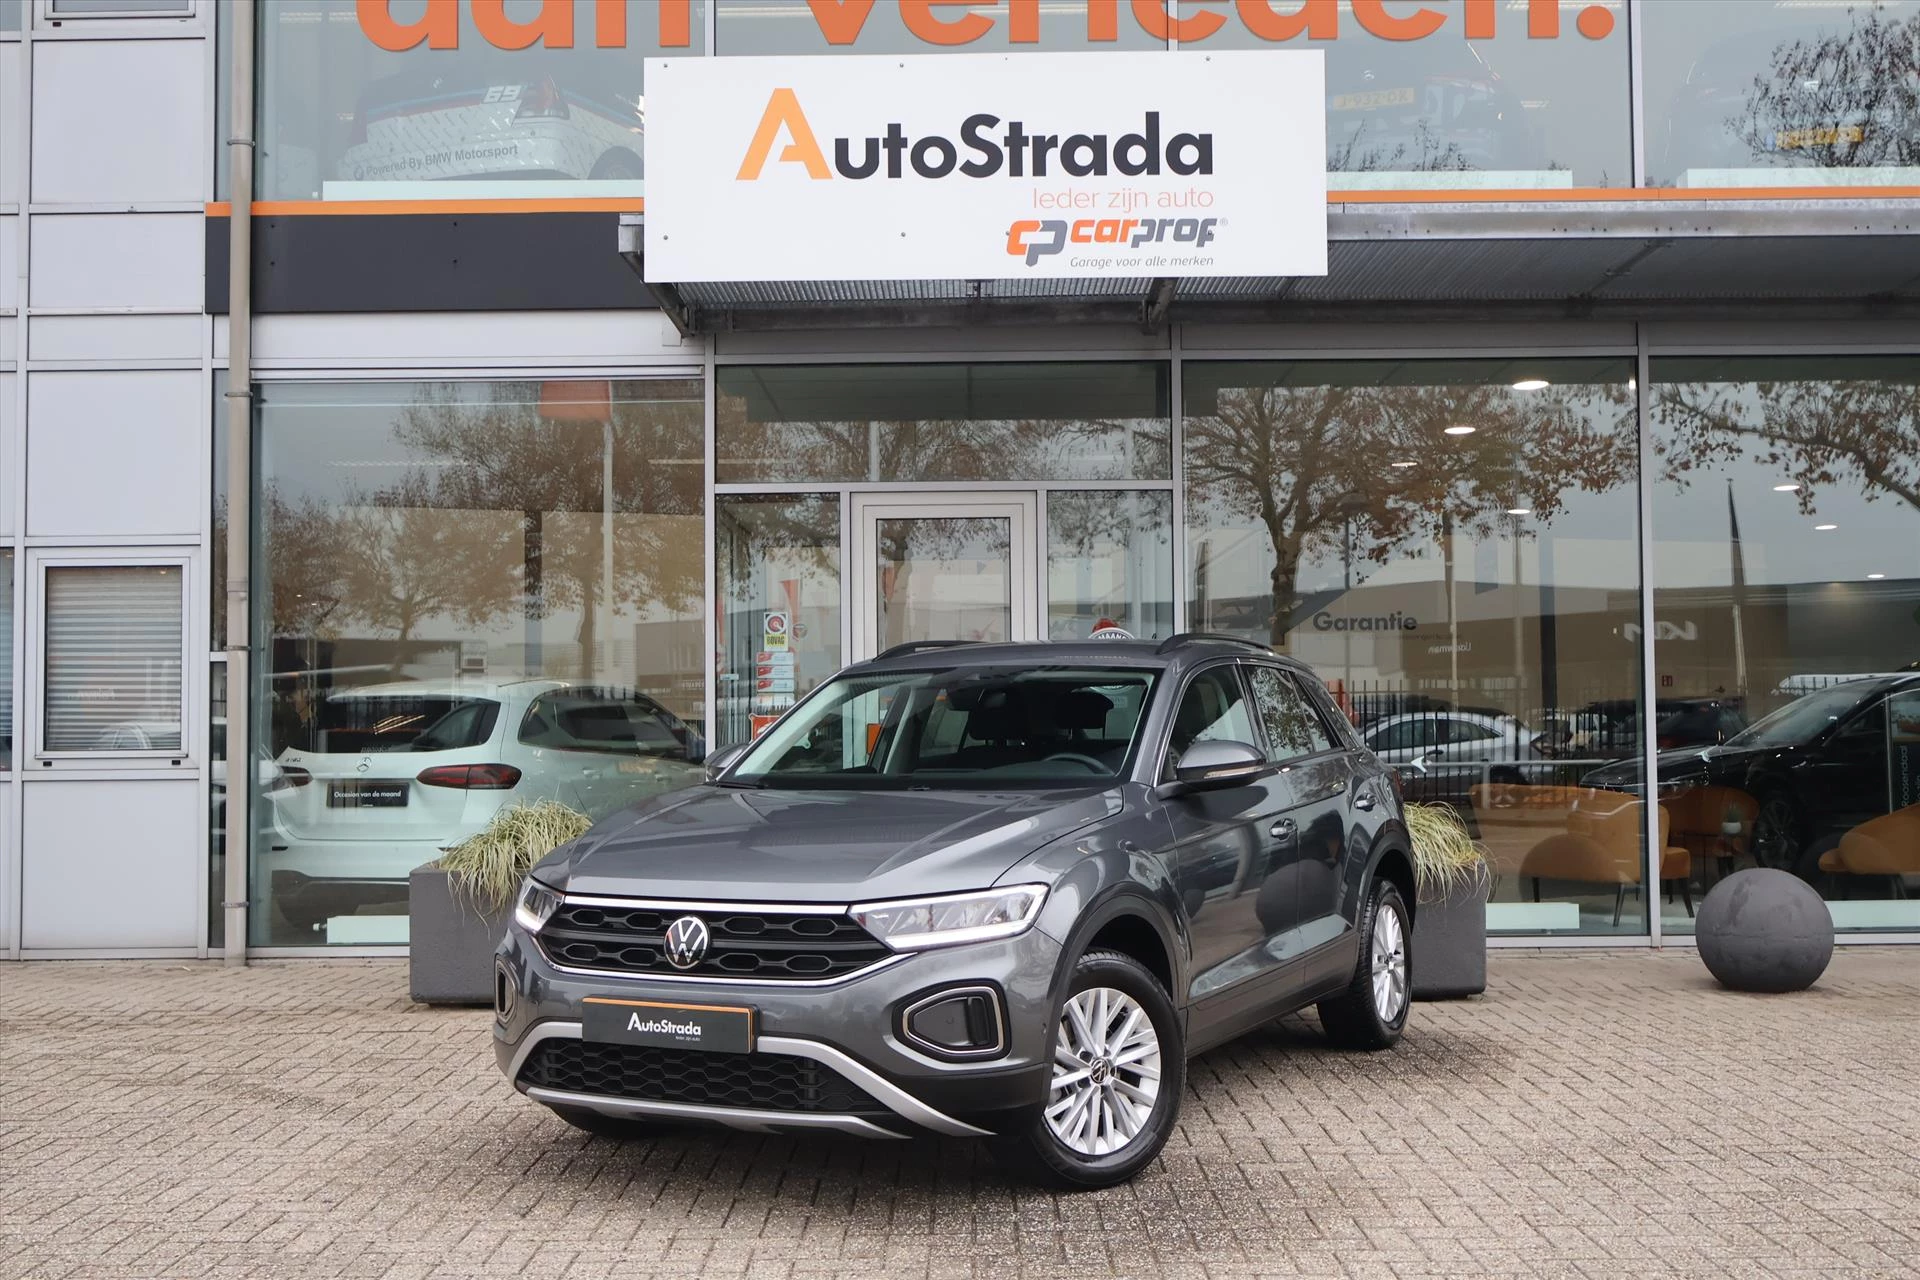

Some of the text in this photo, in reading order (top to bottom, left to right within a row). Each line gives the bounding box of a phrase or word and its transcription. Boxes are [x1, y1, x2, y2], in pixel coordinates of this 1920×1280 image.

[735, 88, 1213, 180] AutoStrada
[366, 144, 519, 176] Powered By BMW Motorsport
[1033, 188, 1213, 213] Ieder zijn auto
[1070, 218, 1218, 249] carprof
[1070, 256, 1213, 269] Garage voor alle merken
[1312, 611, 1418, 631] Garantie
[333, 791, 360, 799] Occasion
[381, 790, 401, 798] maand
[627, 1012, 702, 1036] AutoStrada
